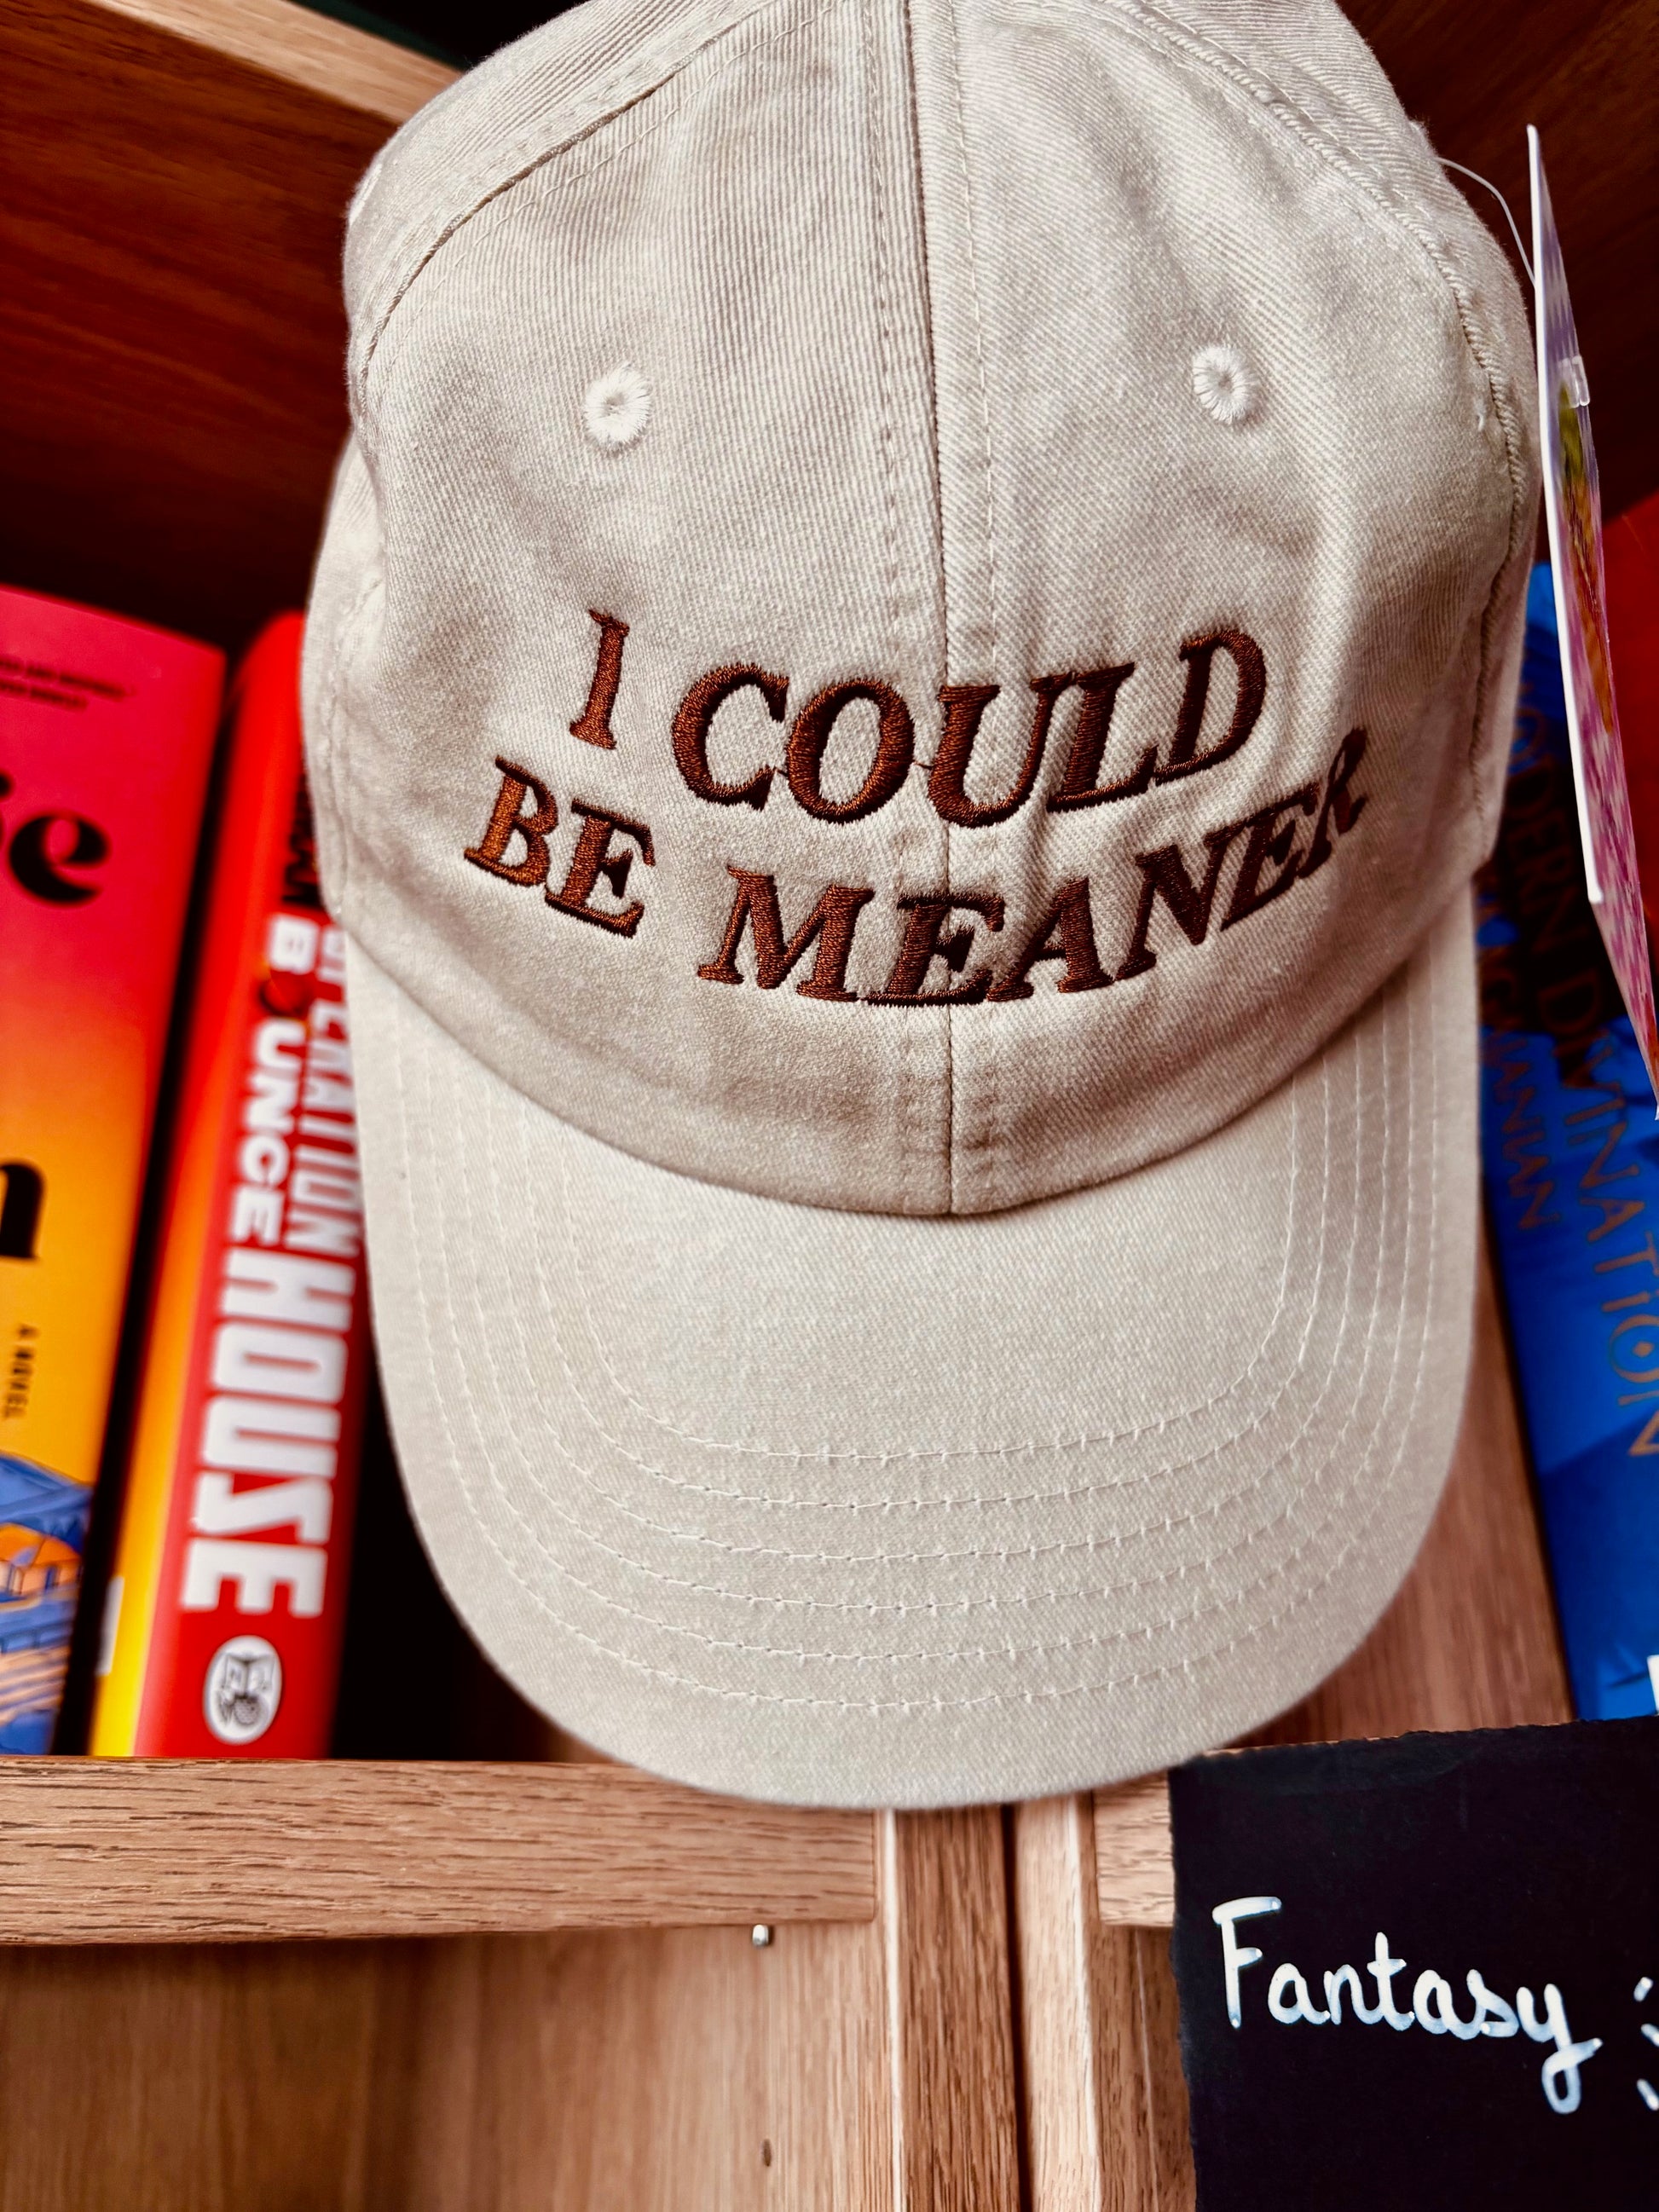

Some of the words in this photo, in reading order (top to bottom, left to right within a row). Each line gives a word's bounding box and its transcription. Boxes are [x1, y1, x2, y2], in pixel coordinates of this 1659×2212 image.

[569, 609, 630, 749] I
[671, 627, 1267, 829] COULD
[464, 754, 656, 939] BE
[697, 727, 1368, 1007] MEANER
[179, 1246, 356, 1620] HOUSE
[1212, 1896, 1604, 2115] Fantasy
